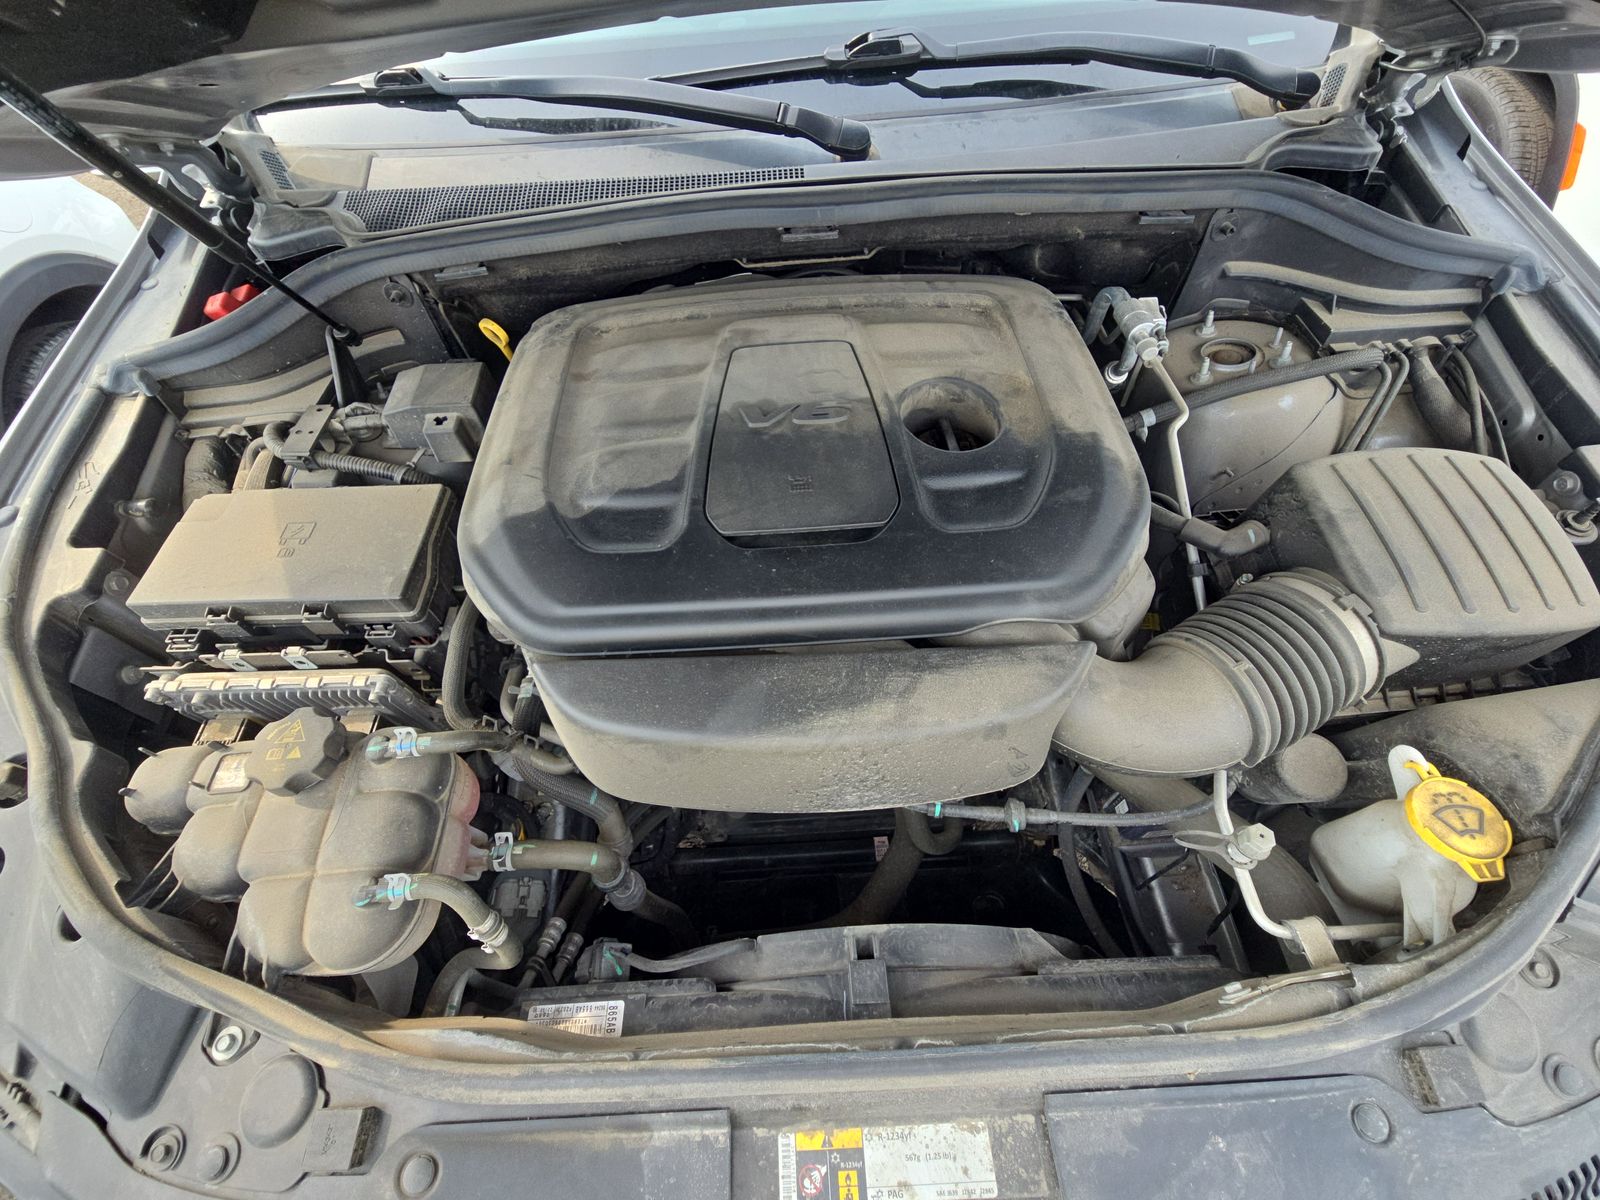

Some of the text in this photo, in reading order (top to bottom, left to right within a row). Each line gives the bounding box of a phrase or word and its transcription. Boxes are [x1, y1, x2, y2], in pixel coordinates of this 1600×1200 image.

[878, 1131, 912, 1142] R-1234yf
[905, 1153, 921, 1162] 567g
[925, 1152, 941, 1162] (1.25
[887, 1189, 904, 1199] PAG
